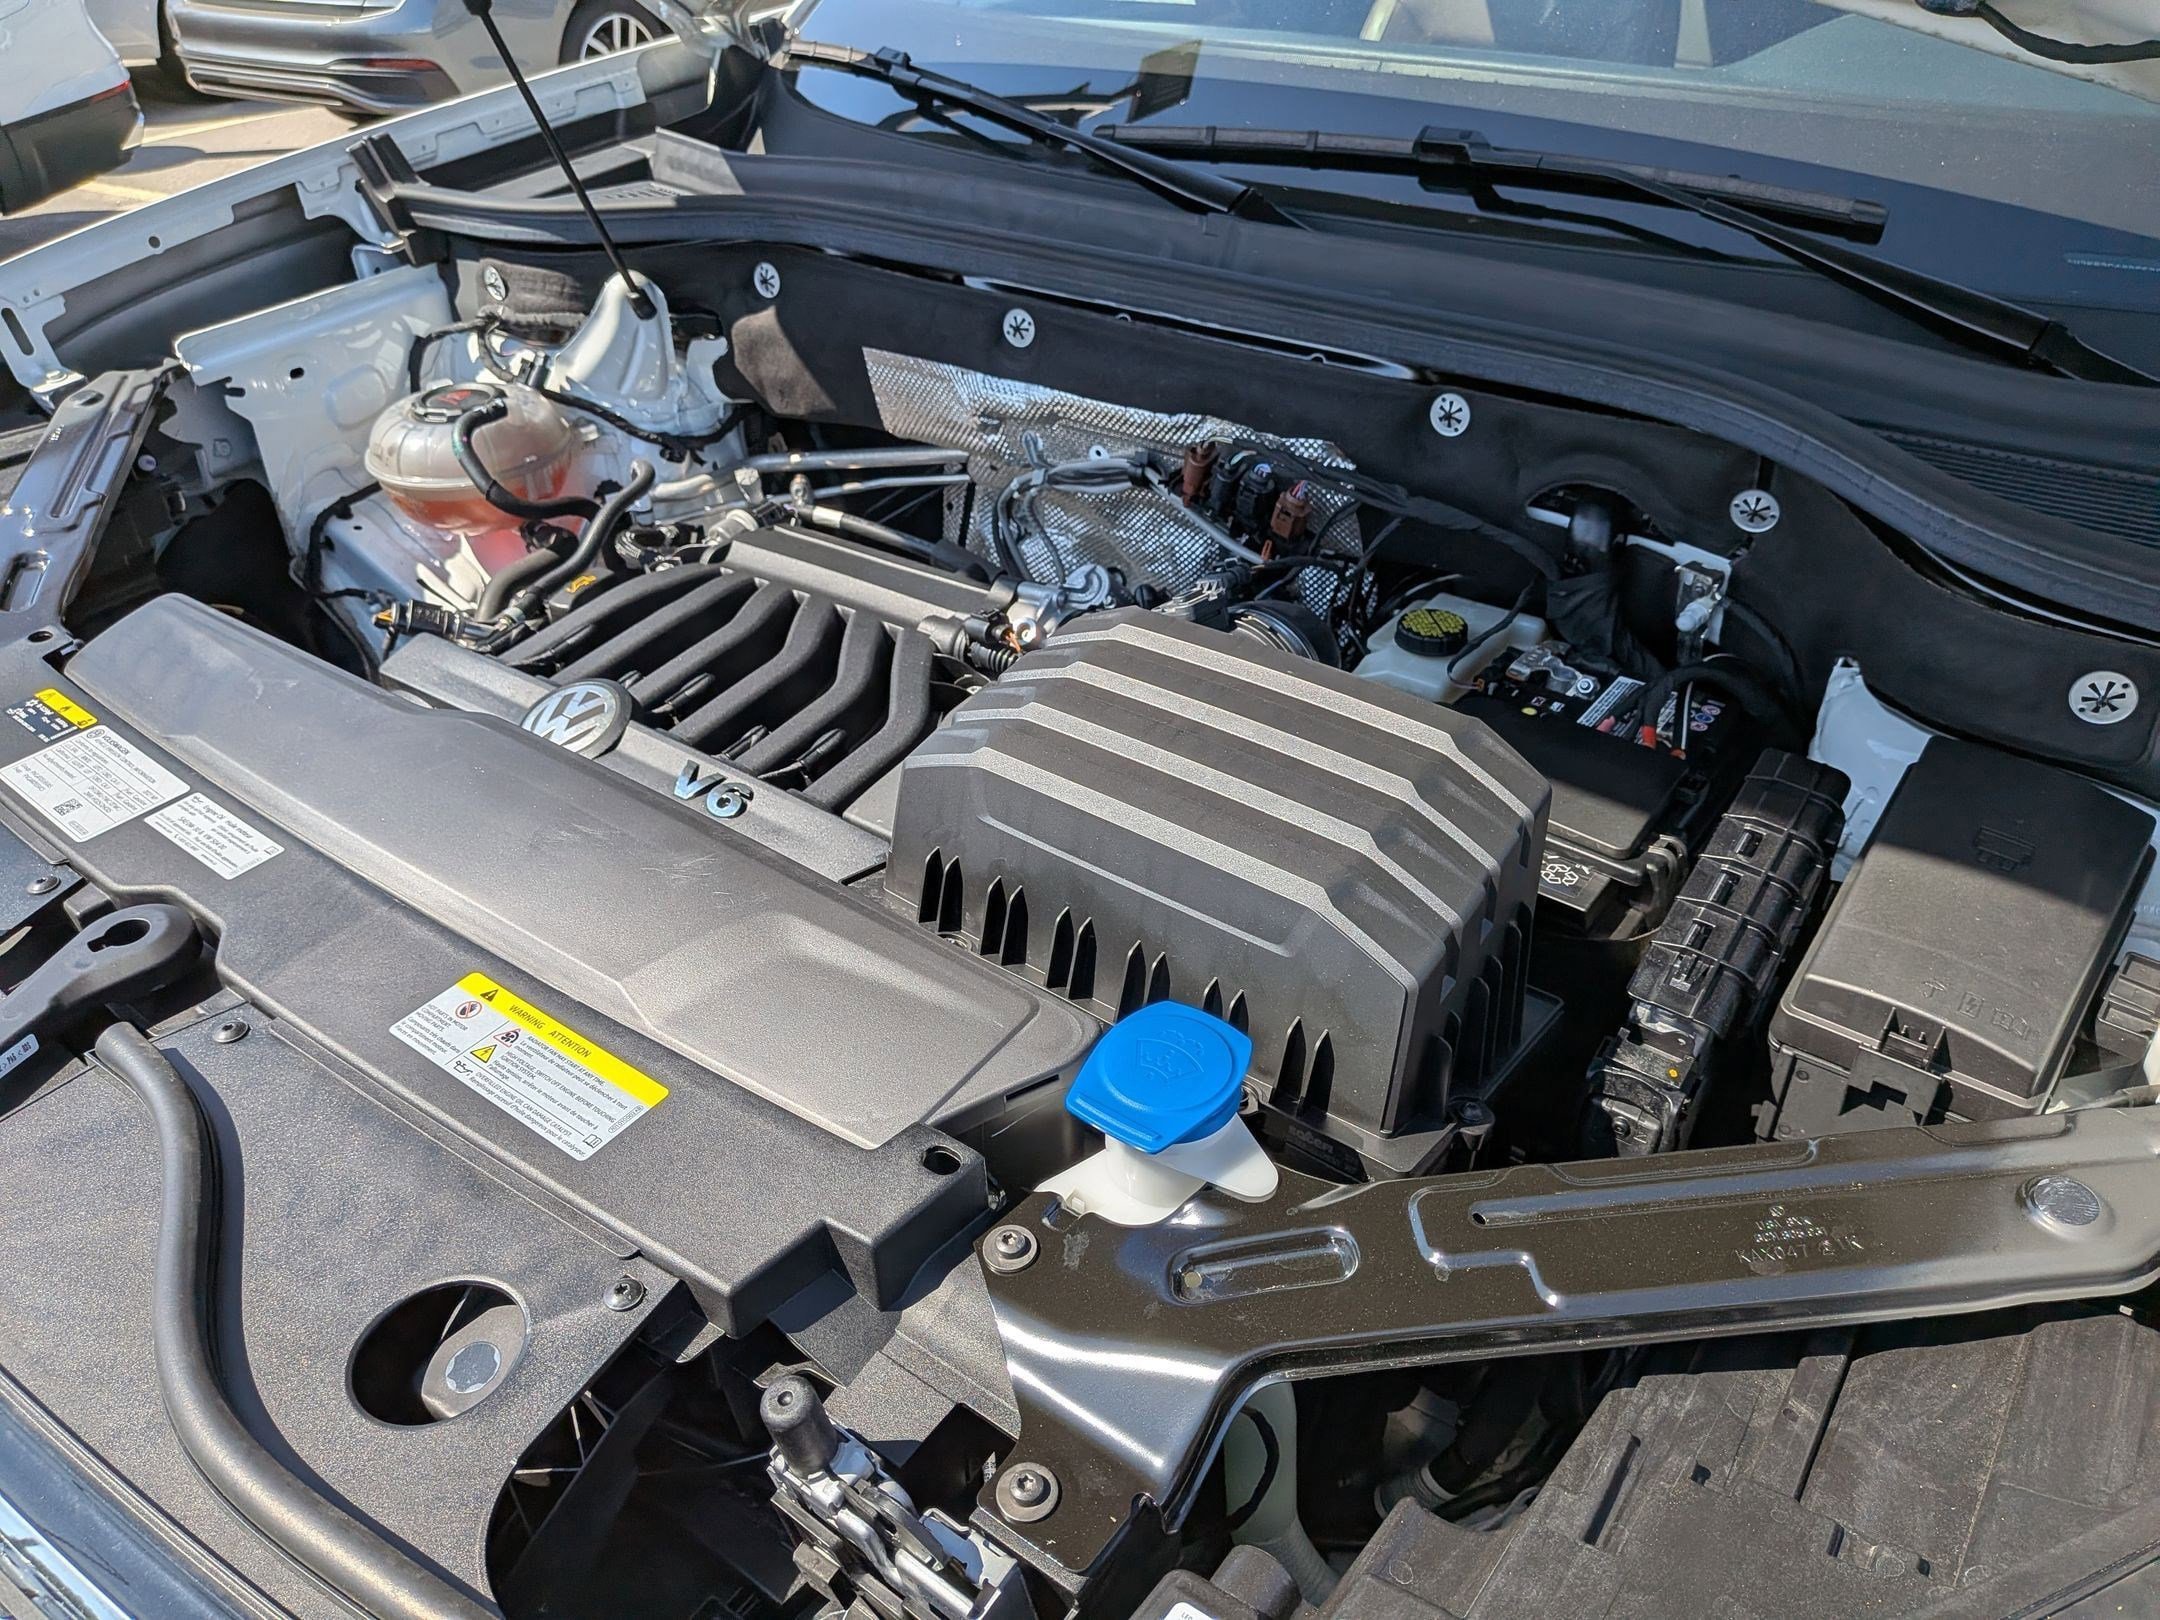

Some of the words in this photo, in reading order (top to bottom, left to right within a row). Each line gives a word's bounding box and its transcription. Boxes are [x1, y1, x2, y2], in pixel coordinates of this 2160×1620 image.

[674, 759, 754, 818] V6
[435, 1009, 449, 1018] PARTS
[452, 1020, 468, 1031] MOTOR
[509, 1005, 545, 1029] WARNING
[548, 1031, 591, 1057] ATTENTION
[500, 1055, 520, 1069] IGNITION
[526, 1045, 549, 1060] ventilateur
[554, 1063, 574, 1076] radiateur
[572, 1075, 585, 1083] peut
[589, 1085, 614, 1101] déclencher
[616, 1101, 628, 1110] tout
[527, 1036, 549, 1051] RADIATOR
[565, 1060, 580, 1070] START
[469, 1077, 495, 1095] Remplissage
[524, 1114, 547, 1130] dangereux
[545, 1129, 558, 1137] pour
[476, 1072, 502, 1090] OVERFILLED
[500, 1088, 517, 1100] ENGINE
[532, 1109, 552, 1123] DAMAGE
[493, 1060, 506, 1070] Haute
[541, 1092, 558, 1104] moteur
[557, 1102, 571, 1112] avant
[576, 1114, 594, 1127] toucher
[506, 1051, 518, 1060] HIGH
[534, 1070, 552, 1082] SWITCH
[559, 1085, 577, 1098] ENGINE
[575, 1096, 594, 1108] BEFORE
[592, 1106, 616, 1123] TOUCHING
